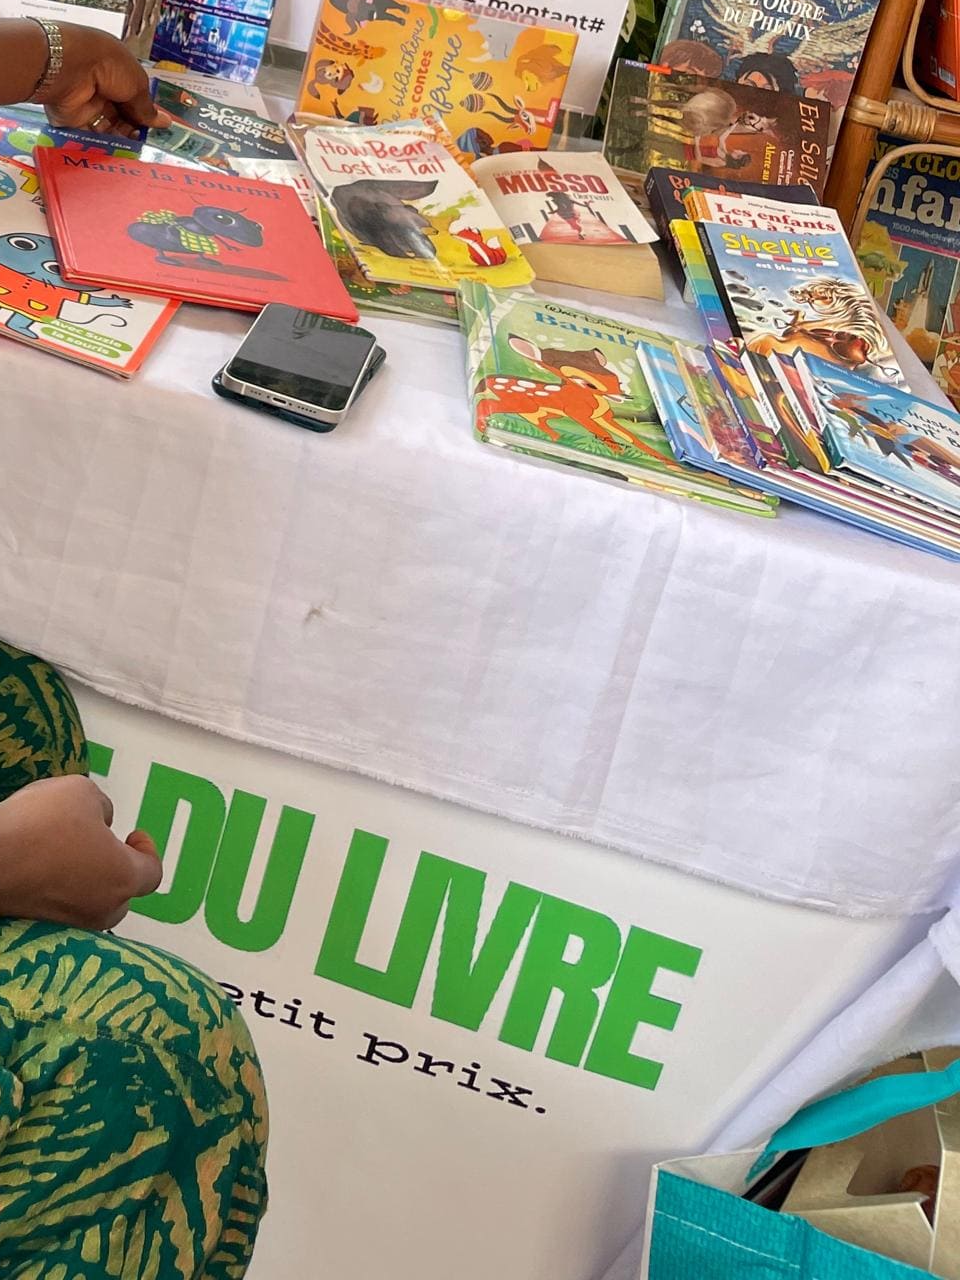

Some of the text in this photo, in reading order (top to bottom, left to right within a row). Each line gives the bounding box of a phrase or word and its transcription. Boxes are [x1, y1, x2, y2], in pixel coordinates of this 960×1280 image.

[722, 6, 816, 41] DU PHÉNIX
[408, 49, 433, 120] de contes
[197, 121, 242, 143] Ouragan
[198, 106, 286, 145] Magique
[218, 108, 286, 137] Cabane
[315, 137, 428, 159] How Bear
[796, 101, 821, 186] En Selle
[320, 155, 446, 177] Lost his Tail
[762, 140, 777, 183] Alerte au
[872, 140, 960, 181] NYCLO
[63, 154, 141, 176] Marie
[150, 168, 173, 182] la
[183, 175, 282, 200] Fourmi
[495, 173, 609, 196] MUSSO
[714, 201, 837, 232] Les enfants
[719, 214, 743, 228] de
[720, 230, 835, 260] Sheltie
[51, 320, 123, 348] Avec Suzie
[51, 330, 110, 355] la souris
[129, 761, 704, 1091] DU LIVRE
[216, 981, 548, 1115] etit prix.
